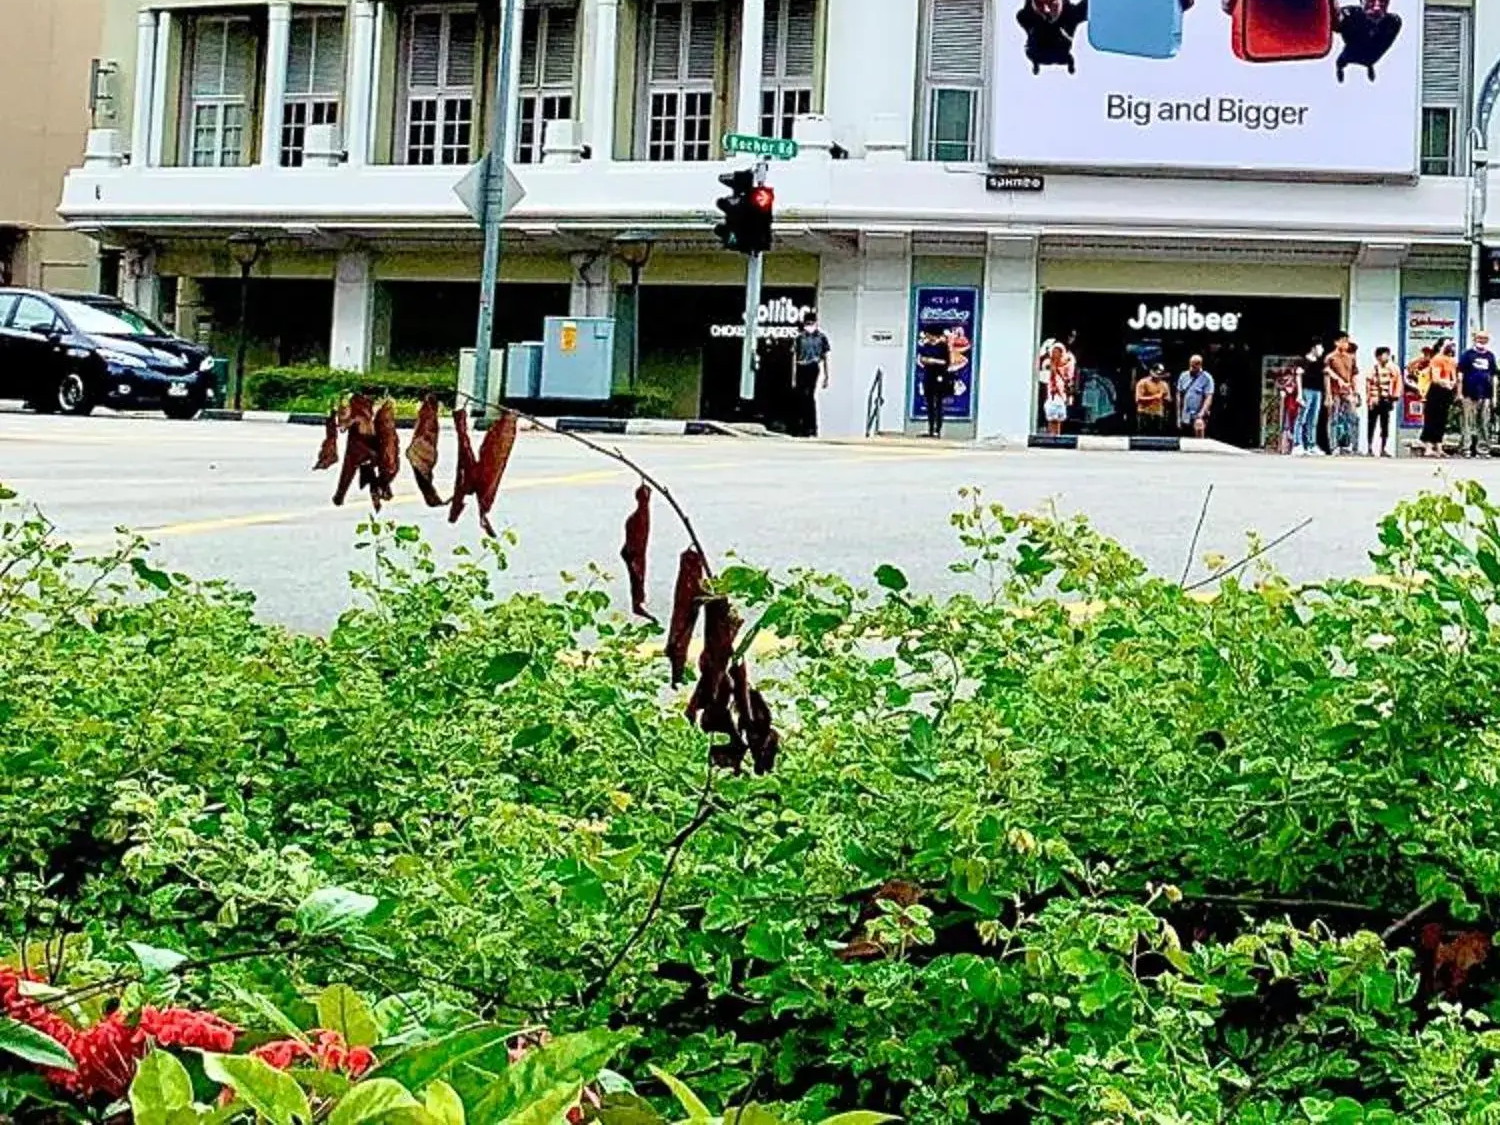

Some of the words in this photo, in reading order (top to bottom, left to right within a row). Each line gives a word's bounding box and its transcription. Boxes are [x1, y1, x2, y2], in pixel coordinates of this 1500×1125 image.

[1107, 94, 1151, 126] Big
[1157, 97, 1211, 122] and
[1217, 98, 1309, 130] Bigger
[731, 136, 774, 153] Rochor
[779, 142, 793, 156] Rd
[742, 296, 816, 325] ollib
[1127, 302, 1239, 332] Jollibee
